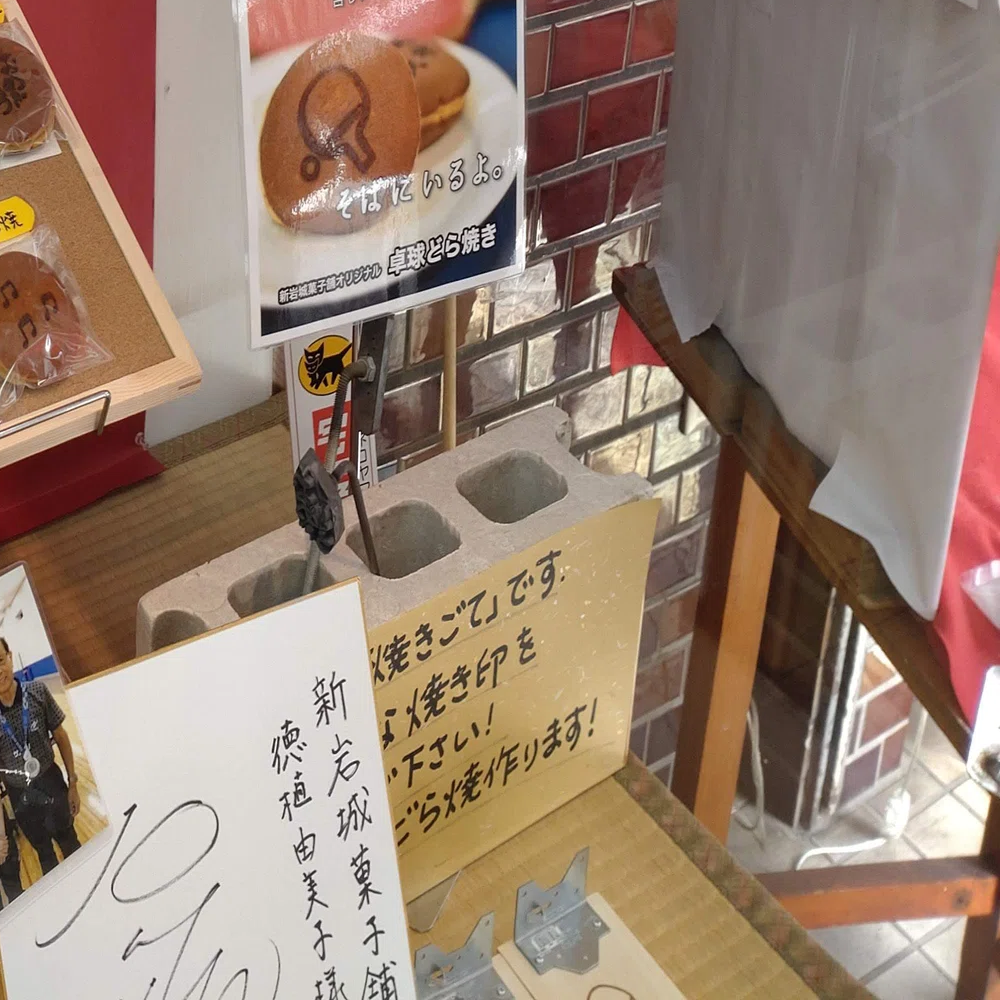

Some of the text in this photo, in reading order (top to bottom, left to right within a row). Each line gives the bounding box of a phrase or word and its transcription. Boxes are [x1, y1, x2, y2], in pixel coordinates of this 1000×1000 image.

[387, 222, 498, 276] 卓球どら焼き
[387, 702, 496, 789] 下さい!
